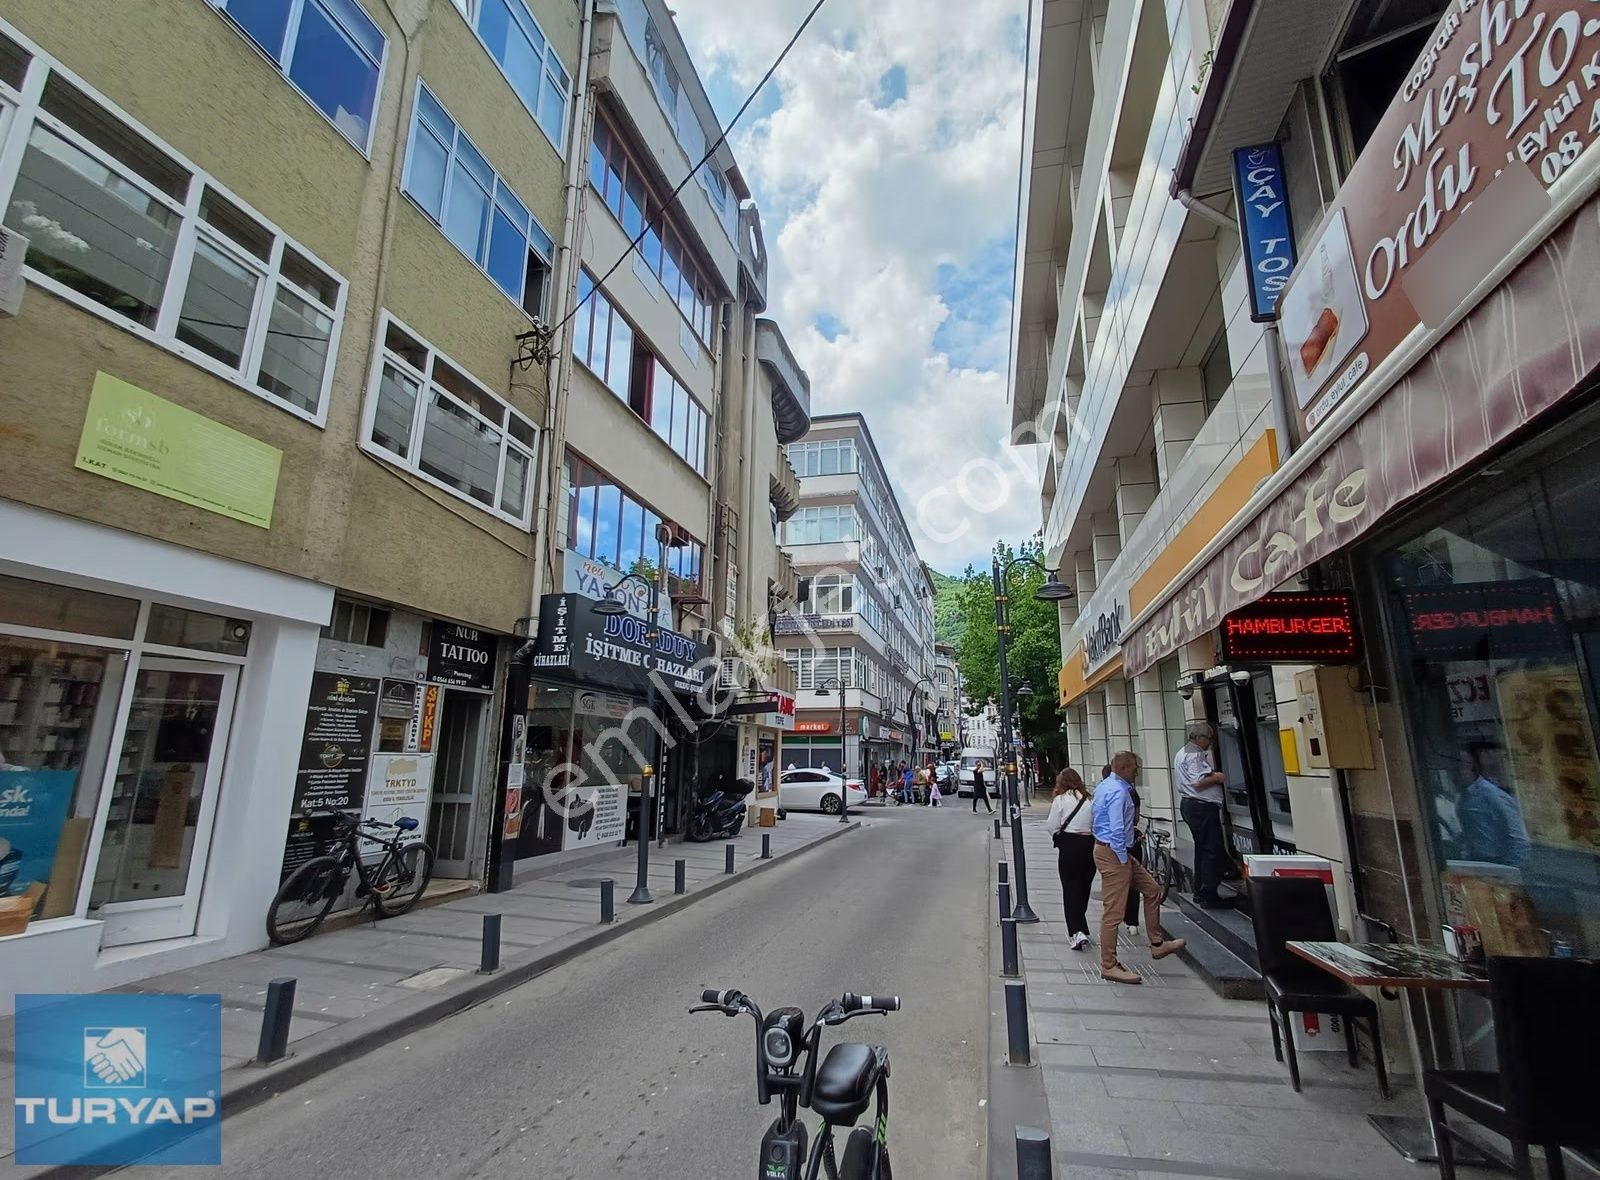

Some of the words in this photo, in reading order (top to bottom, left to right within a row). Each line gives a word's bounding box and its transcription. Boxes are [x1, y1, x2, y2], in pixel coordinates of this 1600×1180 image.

[1393, 0, 1532, 192] Meşh
[1487, 10, 1600, 139] To
[1247, 167, 1284, 219] ÇAY
[1365, 142, 1479, 300] Ordu
[1230, 467, 1368, 592] Cafe
[456, 626, 478, 641] NUR
[552, 596, 567, 652] İŞİTME
[1227, 617, 1345, 634] HAMBURGER
[440, 642, 488, 664] TATTOO
[534, 652, 570, 667] CİHAZLARI
[585, 632, 641, 668] İŞİTME
[642, 653, 704, 684] CHAZLARI
[800, 722, 825, 731] market
